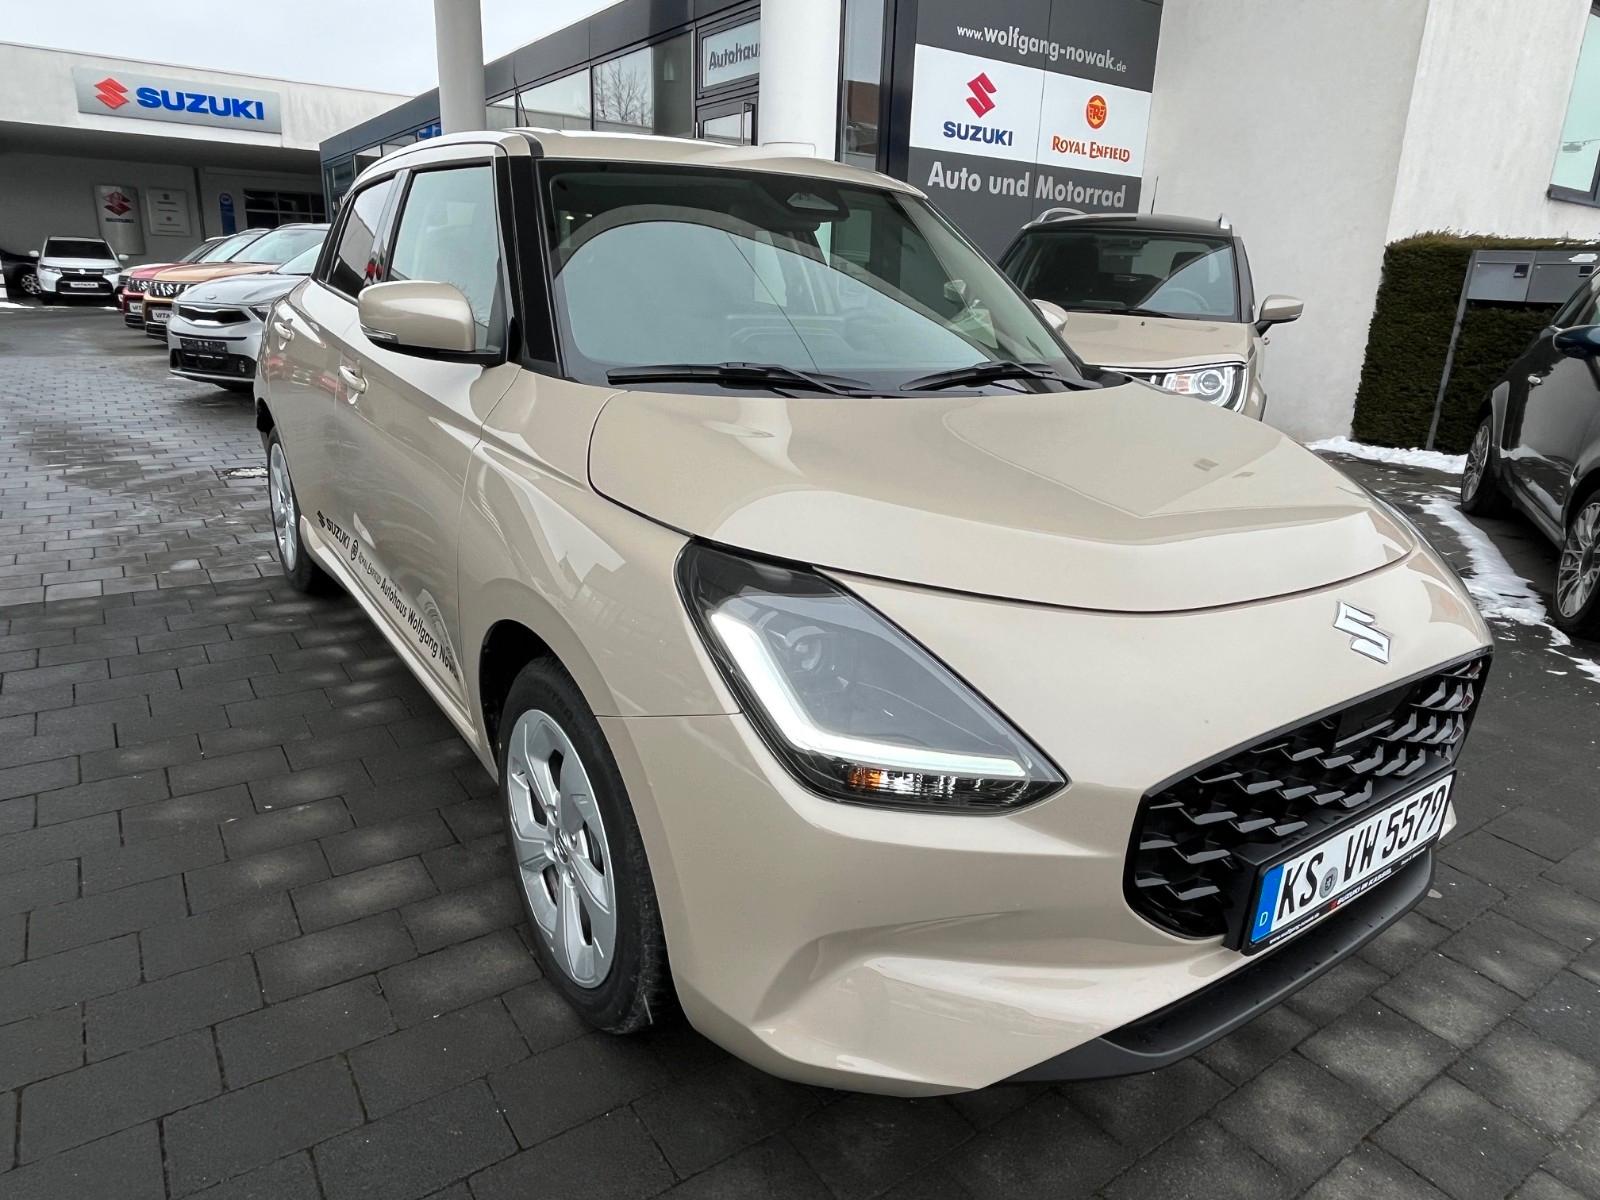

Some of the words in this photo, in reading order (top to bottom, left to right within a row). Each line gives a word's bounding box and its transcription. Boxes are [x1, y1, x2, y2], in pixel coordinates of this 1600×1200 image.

[956, 26, 1127, 73] www.wolfgang-nowak.de
[136, 86, 265, 121] SUZUKI
[943, 120, 1013, 147] SUZUKI
[1052, 135, 1087, 156] ROYAL
[1089, 141, 1130, 163] ENFIELD
[927, 161, 982, 192] Auto
[988, 171, 1030, 198] und
[1035, 174, 1126, 208] Motorrad
[326, 518, 350, 550] SUZUKI
[381, 577, 408, 618] Autohaus
[407, 607, 438, 658] Wolfgang
[1277, 851, 1324, 922] KS
[1343, 819, 1382, 882] VW
[1259, 911, 1268, 926] D
